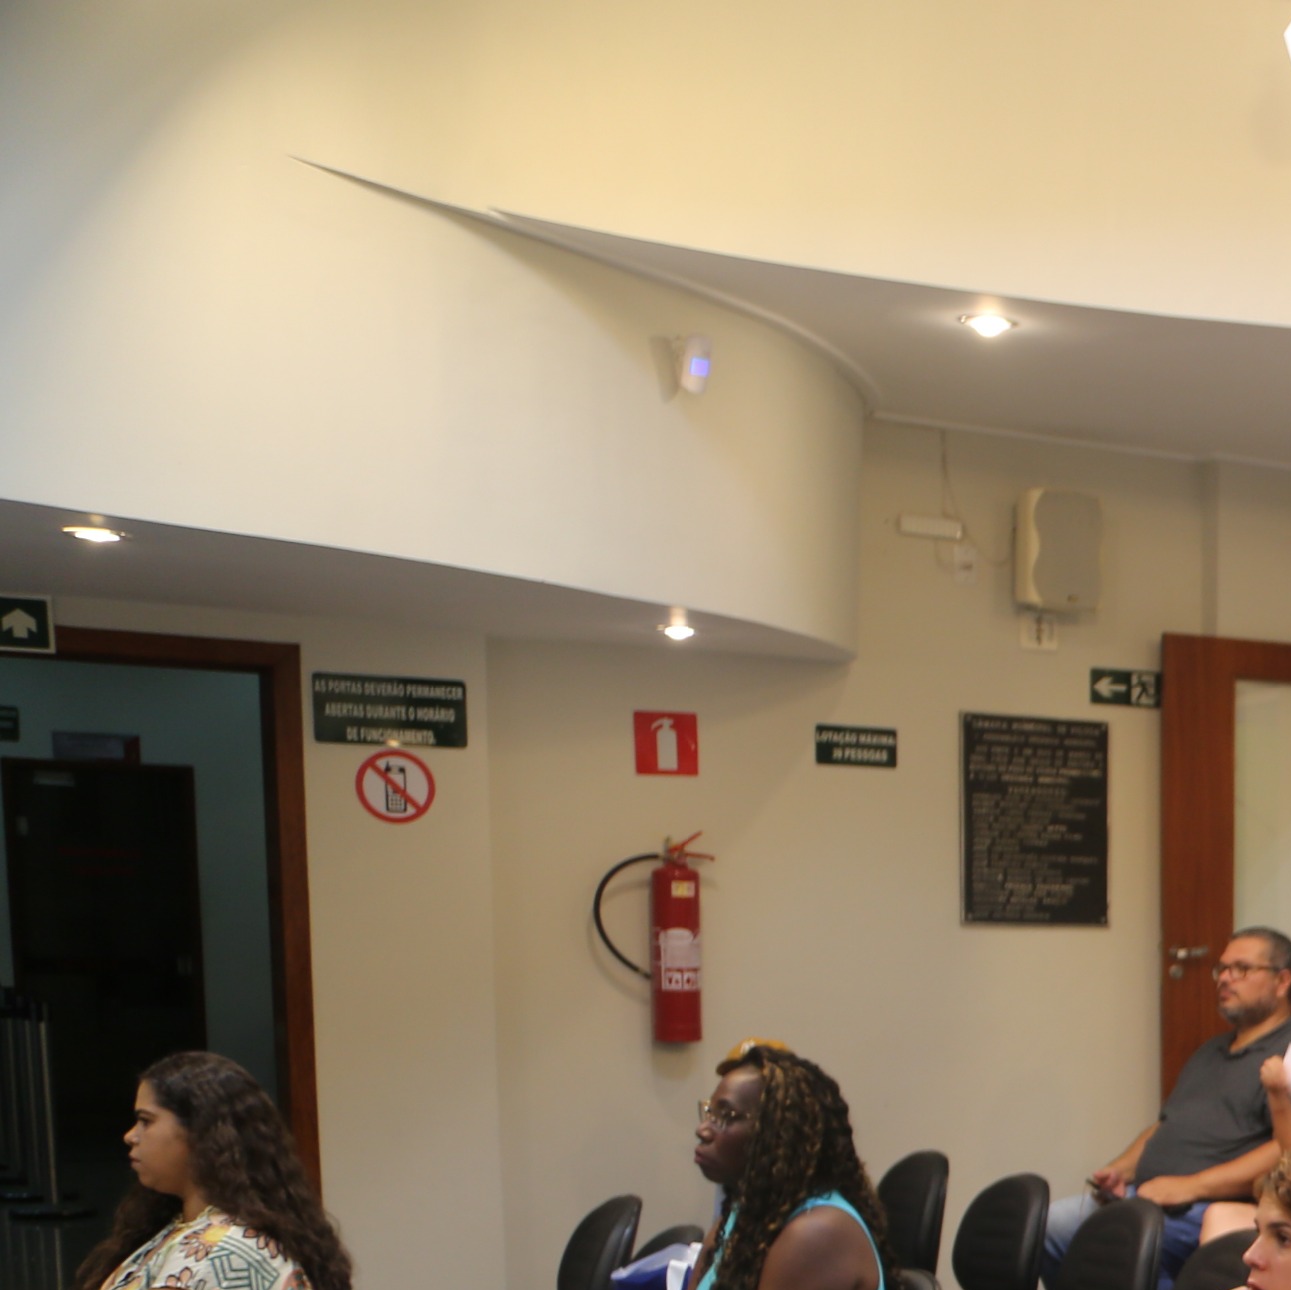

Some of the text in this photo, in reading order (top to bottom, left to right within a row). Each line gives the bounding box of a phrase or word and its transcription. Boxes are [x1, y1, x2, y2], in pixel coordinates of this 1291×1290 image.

[314, 679, 464, 701] AS PORTAS DEVERÃO PERMANECER
[324, 701, 364, 718] ABERTAS
[365, 703, 407, 721] DURANTE
[346, 726, 359, 742] DE
